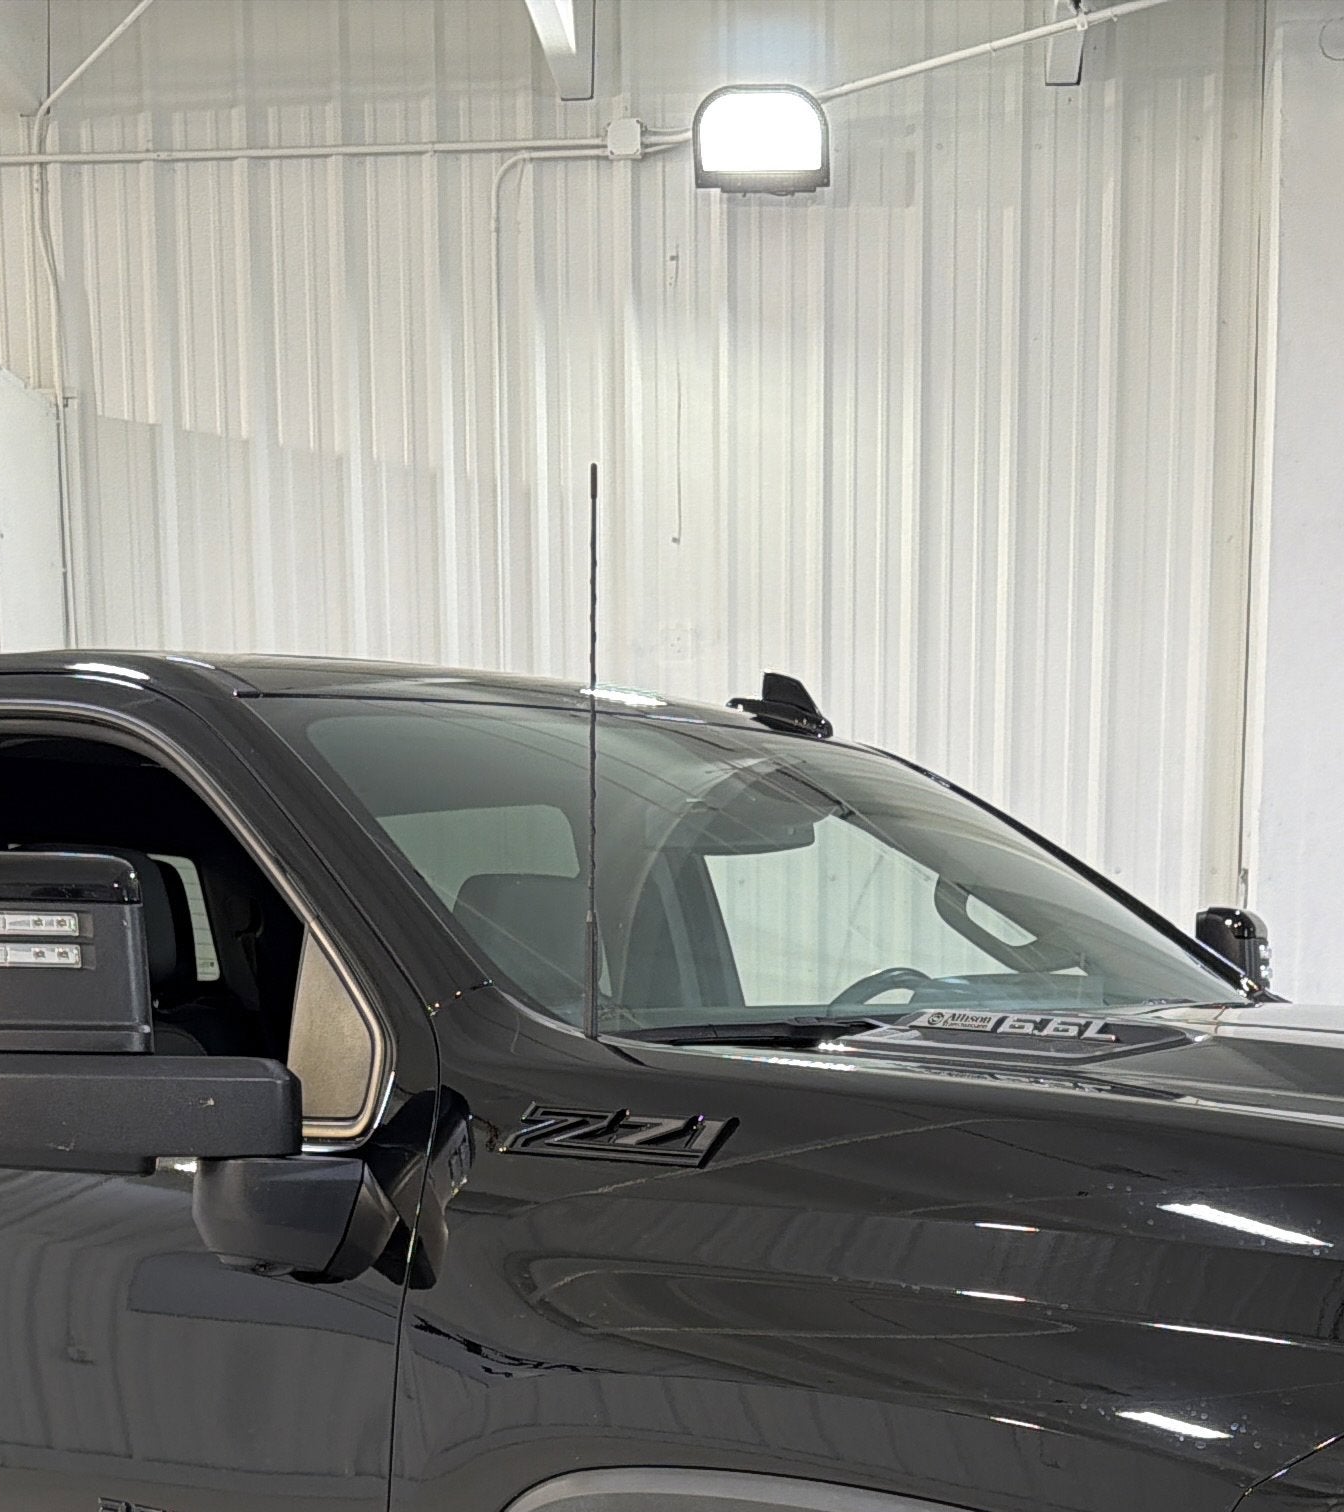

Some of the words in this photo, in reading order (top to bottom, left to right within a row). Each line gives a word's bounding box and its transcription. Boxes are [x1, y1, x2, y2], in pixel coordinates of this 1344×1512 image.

[943, 1012, 993, 1025] Allison
[997, 1016, 1119, 1042] 6.6L
[500, 1101, 740, 1168] Z71
